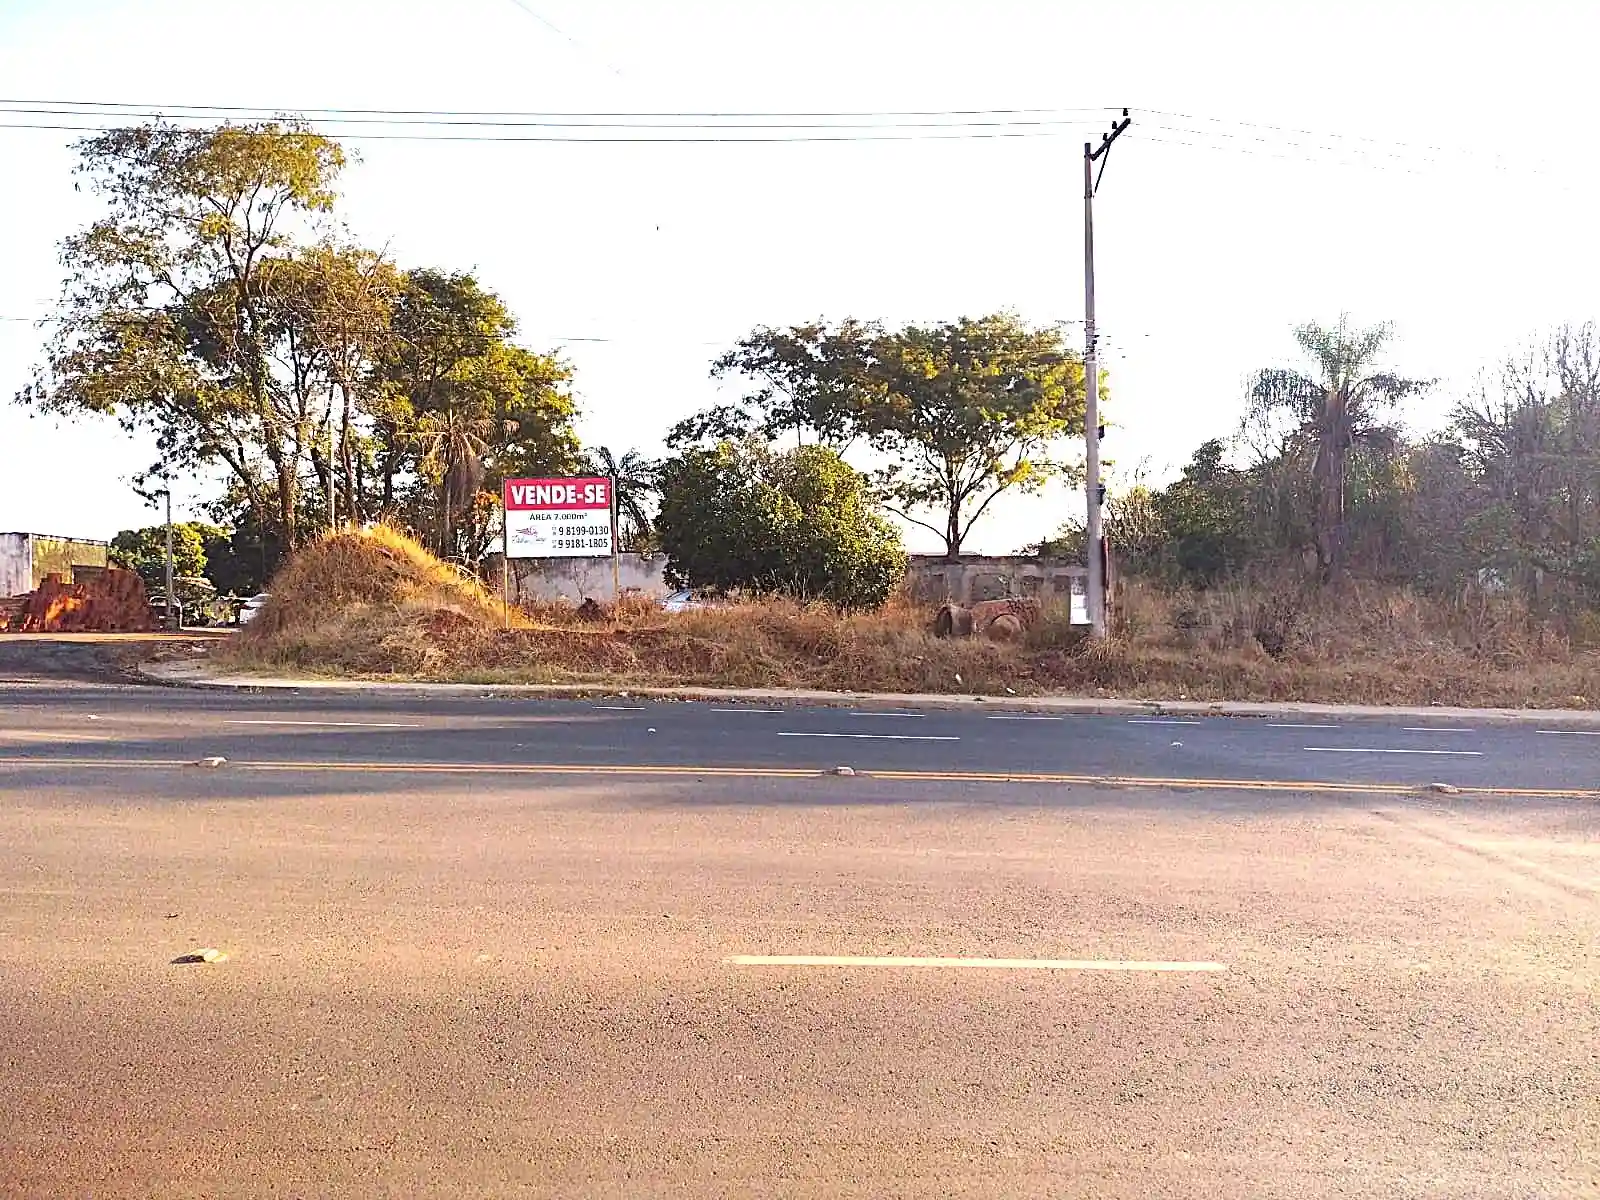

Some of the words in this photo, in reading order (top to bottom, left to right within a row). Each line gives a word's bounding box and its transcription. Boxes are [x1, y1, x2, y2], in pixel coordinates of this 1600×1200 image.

[511, 484, 606, 505] VENDE-SE
[558, 526, 564, 535] 9
[566, 525, 609, 536] 8199-0130
[558, 539, 563, 548] 9
